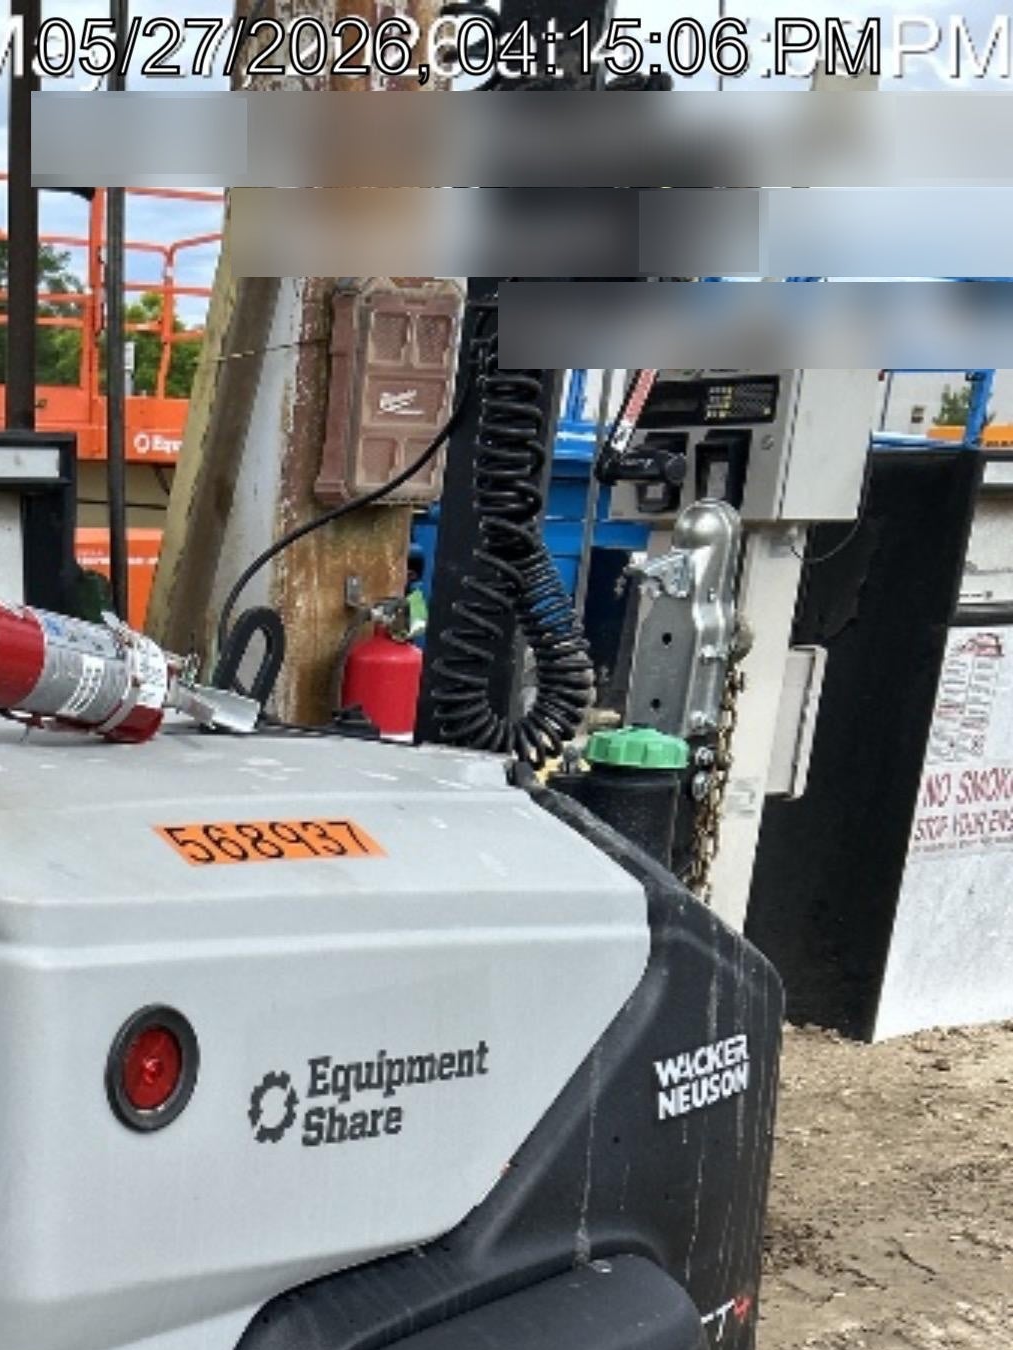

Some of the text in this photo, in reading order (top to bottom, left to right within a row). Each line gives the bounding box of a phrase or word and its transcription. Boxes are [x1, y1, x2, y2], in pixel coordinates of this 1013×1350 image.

[163, 820, 370, 864] 568937
[307, 1040, 489, 1103] Equipment
[654, 1034, 750, 1088] WACKER
[658, 1060, 751, 1121] NEUSON
[301, 1105, 403, 1147] Share
